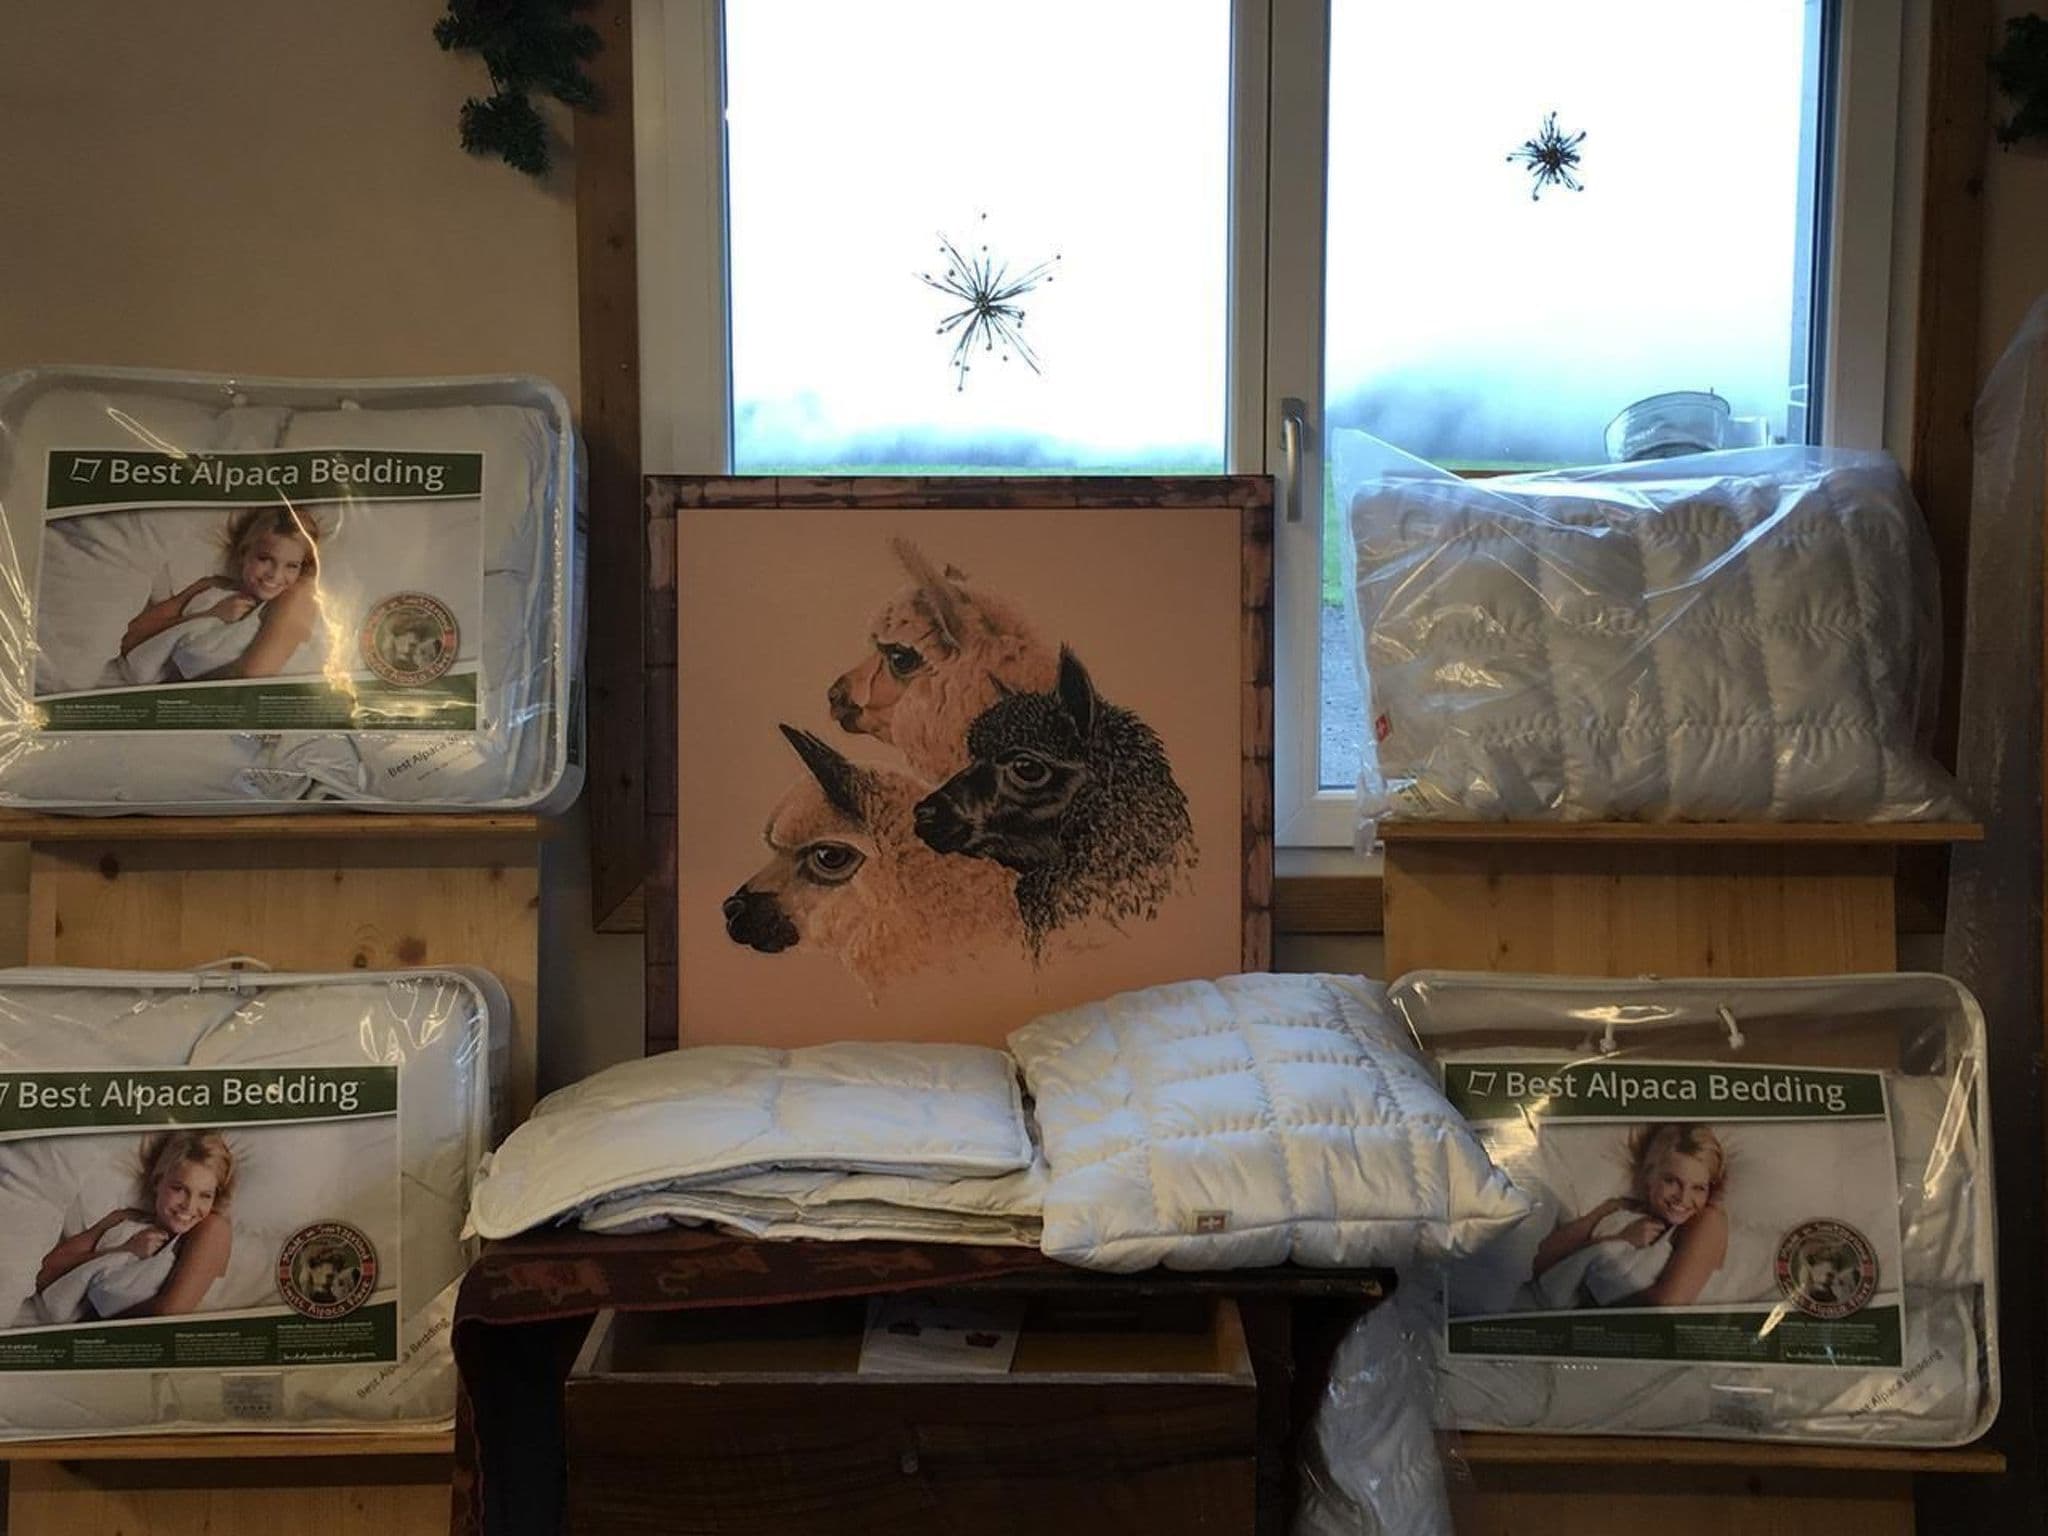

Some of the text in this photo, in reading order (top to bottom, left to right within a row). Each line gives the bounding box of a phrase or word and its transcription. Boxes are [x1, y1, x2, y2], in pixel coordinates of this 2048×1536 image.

[110, 457, 444, 493] Best Alpaca Bedding
[18, 1075, 359, 1115] Best Alpaca Bedding
[1506, 1070, 1846, 1112] Best Alpaca Bedding
